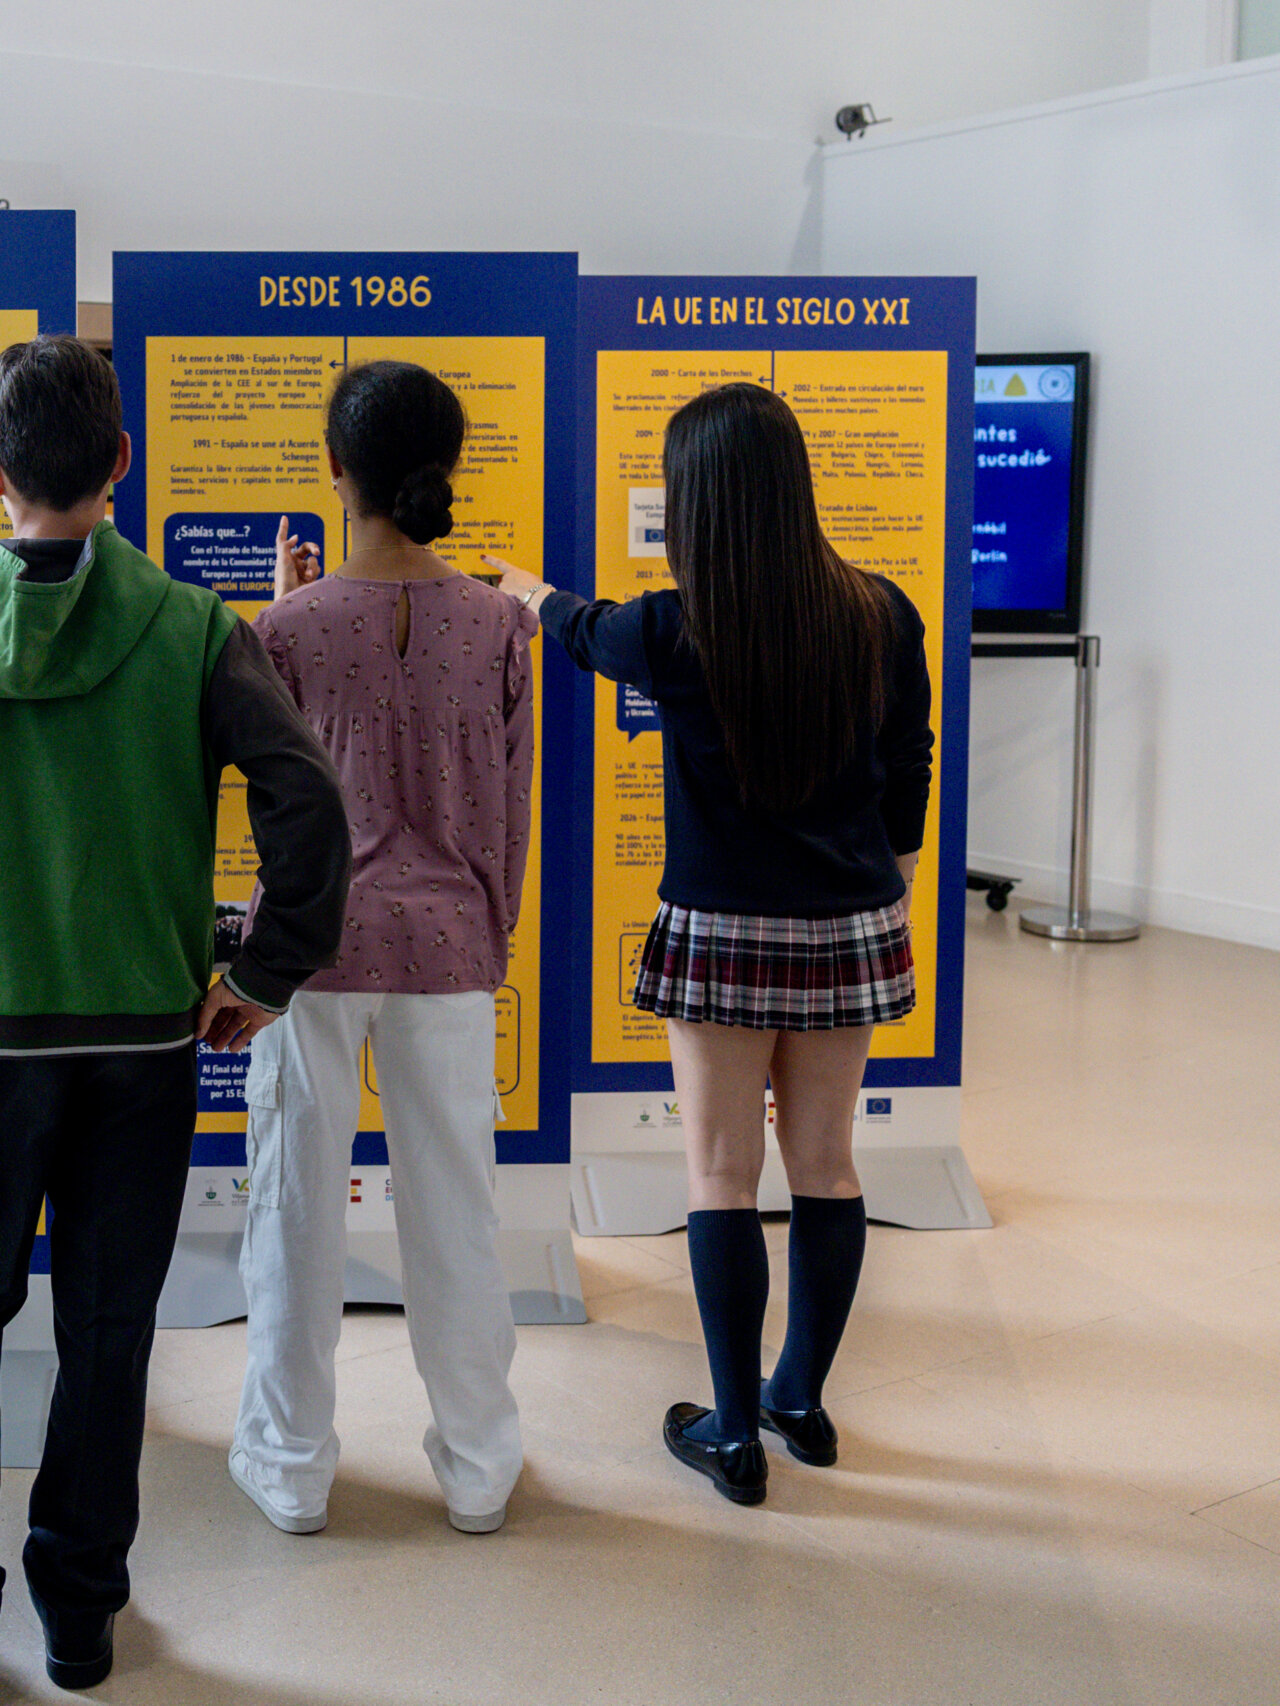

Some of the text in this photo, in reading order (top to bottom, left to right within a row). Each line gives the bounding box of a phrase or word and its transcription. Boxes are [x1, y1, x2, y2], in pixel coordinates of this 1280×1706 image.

[260, 276, 431, 307] DESDE 1986
[637, 296, 910, 325] LA UE EN EL SIGLO XXI
